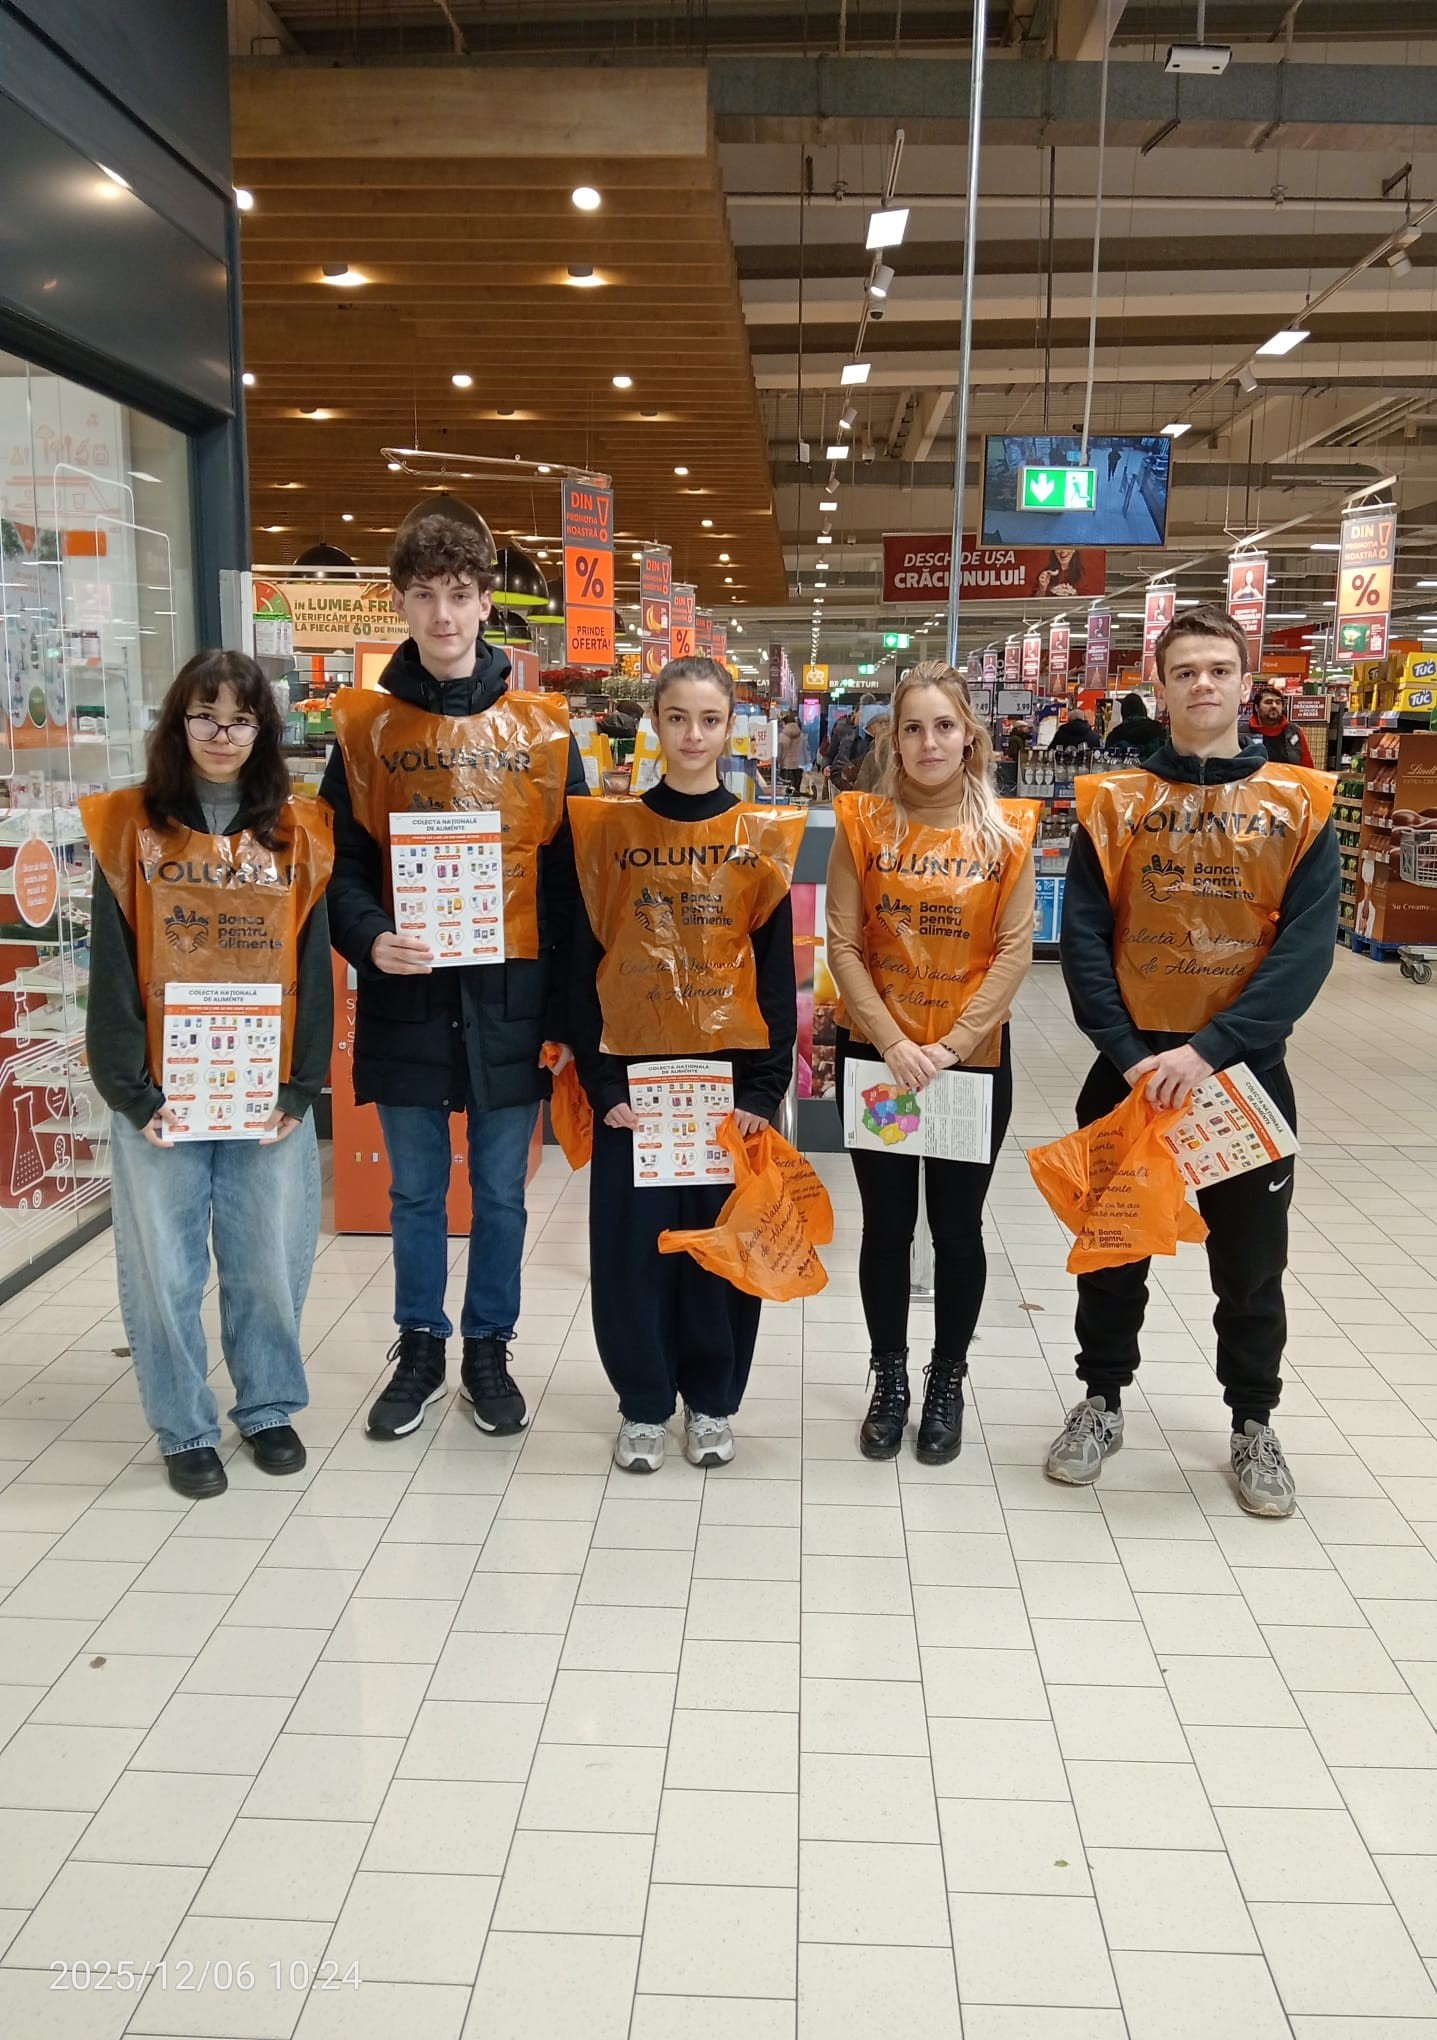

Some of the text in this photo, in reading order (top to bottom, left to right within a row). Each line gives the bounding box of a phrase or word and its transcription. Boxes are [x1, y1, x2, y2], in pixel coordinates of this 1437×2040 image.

[571, 491, 593, 511] DIN
[1351, 524, 1375, 539] DIN
[903, 550, 1016, 567] DESCHDE UȘA
[307, 598, 363, 612] LUMEA
[295, 622, 409, 636] LA FIECARE 60 DE MINU
[576, 625, 605, 637] PRINDE
[571, 637, 611, 650] OFERTA!
[1414, 663, 1435, 677] TUC
[1410, 693, 1430, 706] TUC
[1128, 810, 1289, 838] VOLUNTAR
[1193, 862, 1240, 875] Banca
[919, 901, 962, 915] Banca
[919, 914, 962, 927] pentru
[919, 924, 970, 940] alimente
[1165, 958, 1248, 976] Alimente
[188, 989, 219, 997] COLECTA
